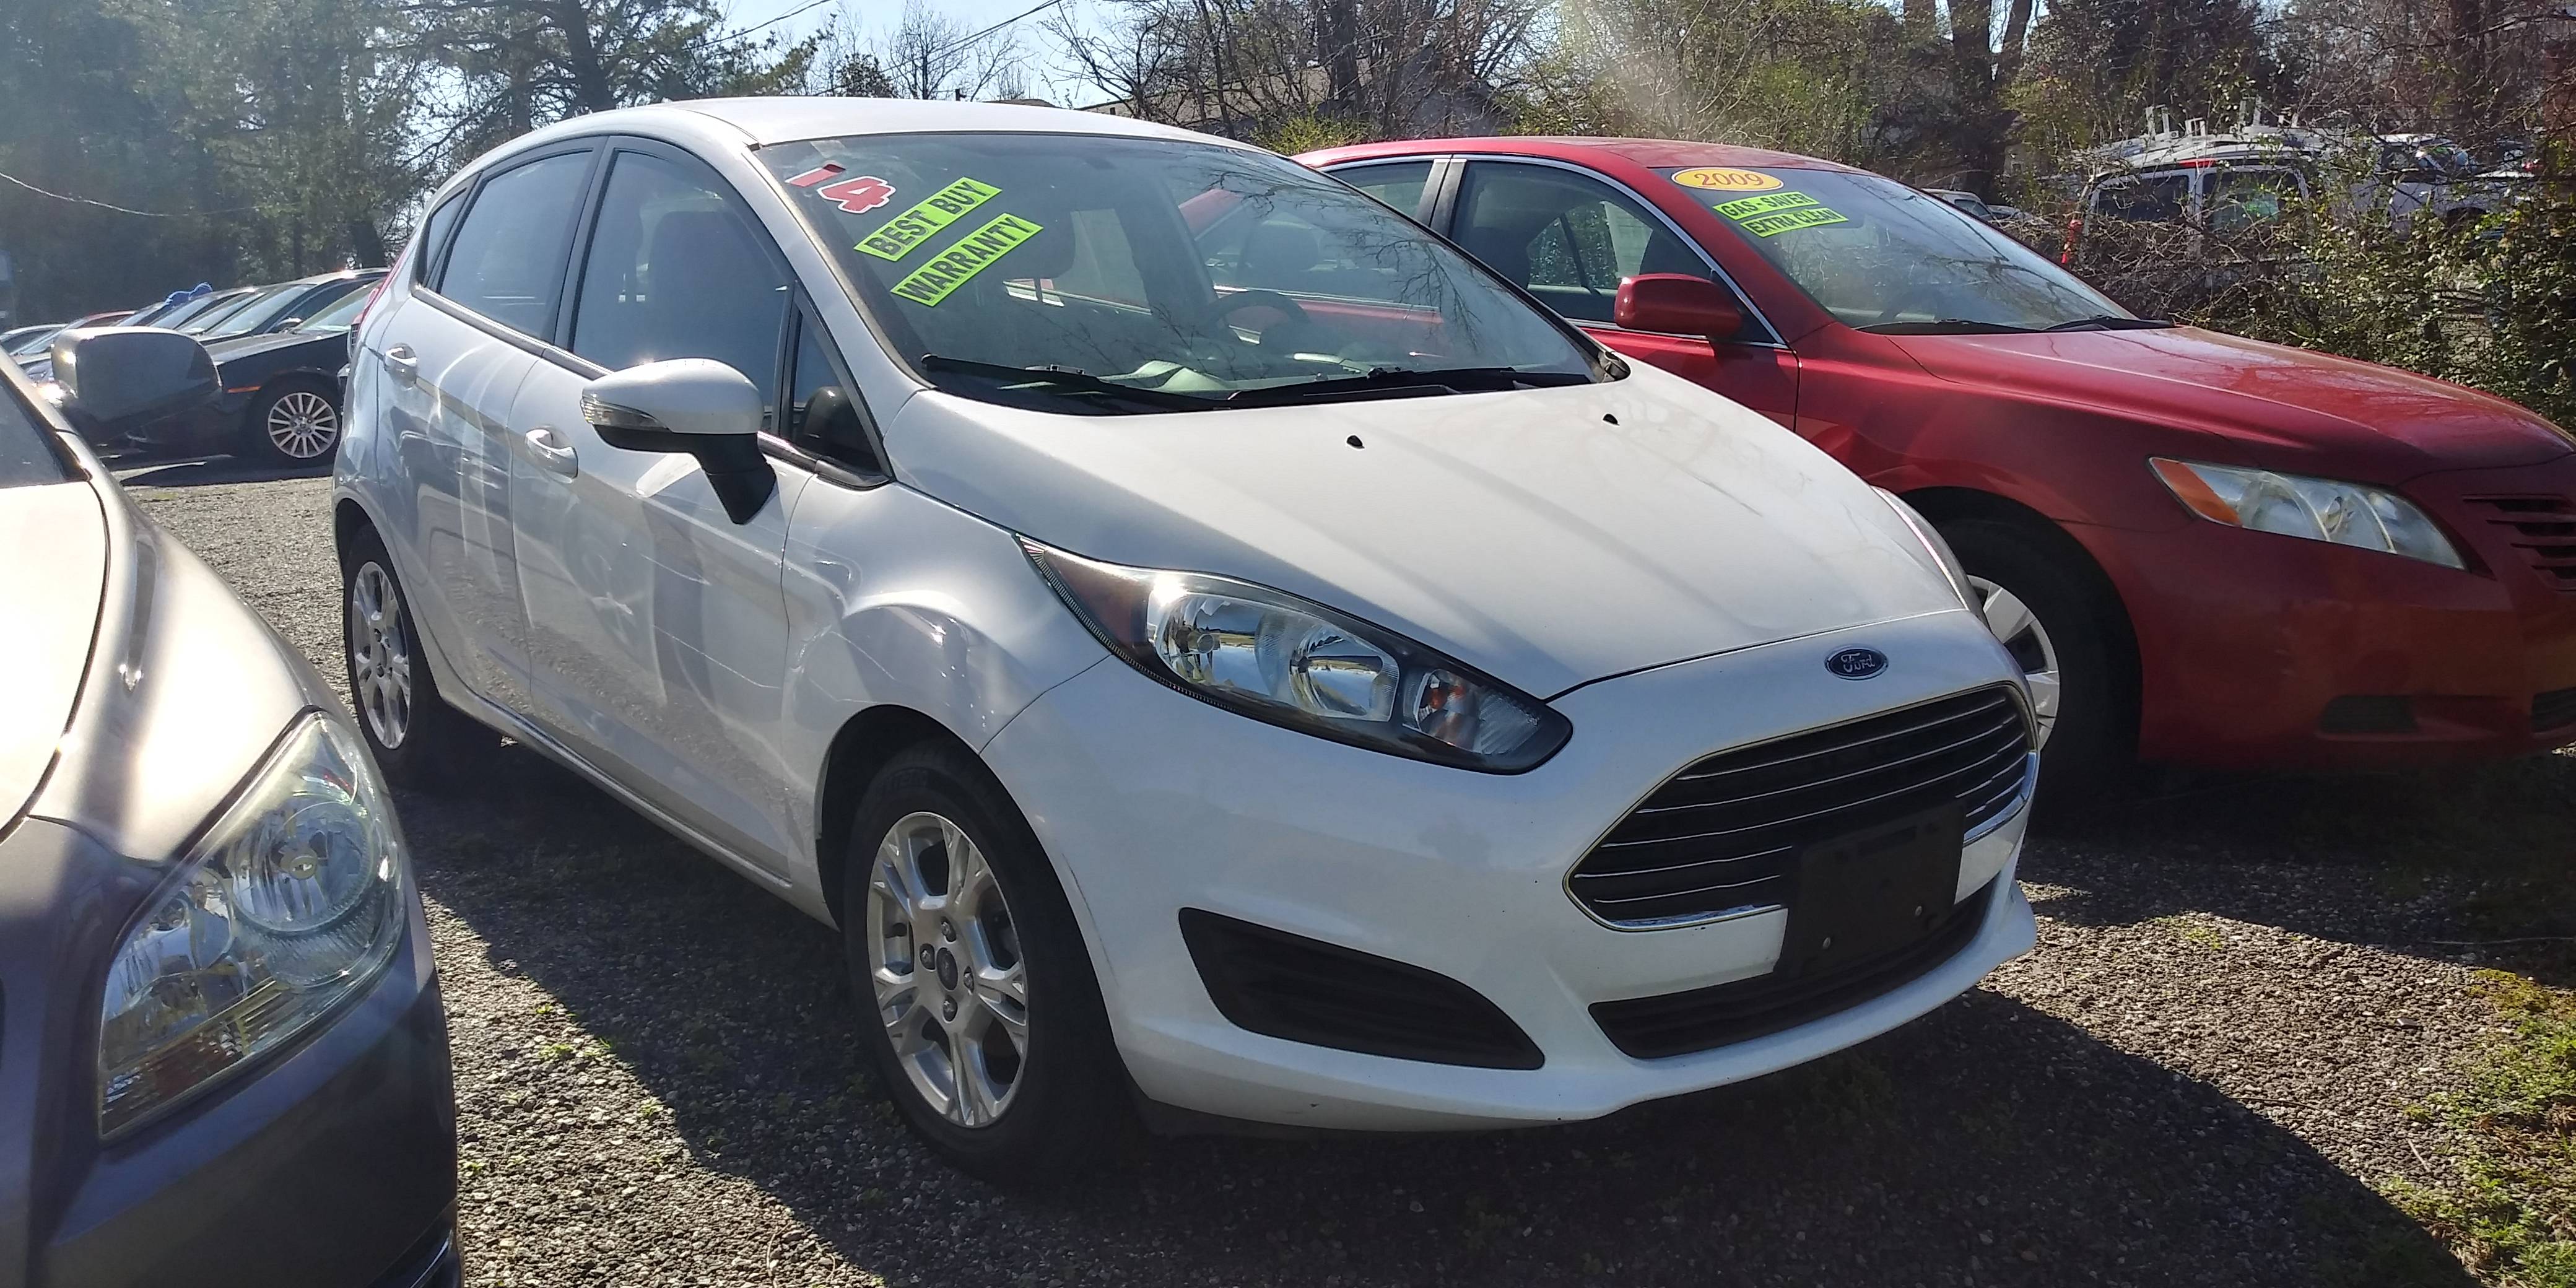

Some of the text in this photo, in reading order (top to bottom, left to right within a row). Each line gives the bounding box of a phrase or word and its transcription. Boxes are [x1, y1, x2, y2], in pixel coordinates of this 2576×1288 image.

[1694, 173, 1764, 186] 2009
[1721, 201, 1759, 216] GAS
[1760, 193, 1814, 207] SAVER
[863, 181, 991, 256] BEST BUY
[1745, 209, 1845, 233] EXTRA CLEAN
[897, 217, 1033, 301] WARRANTY
[1840, 652, 1876, 672] Ford
